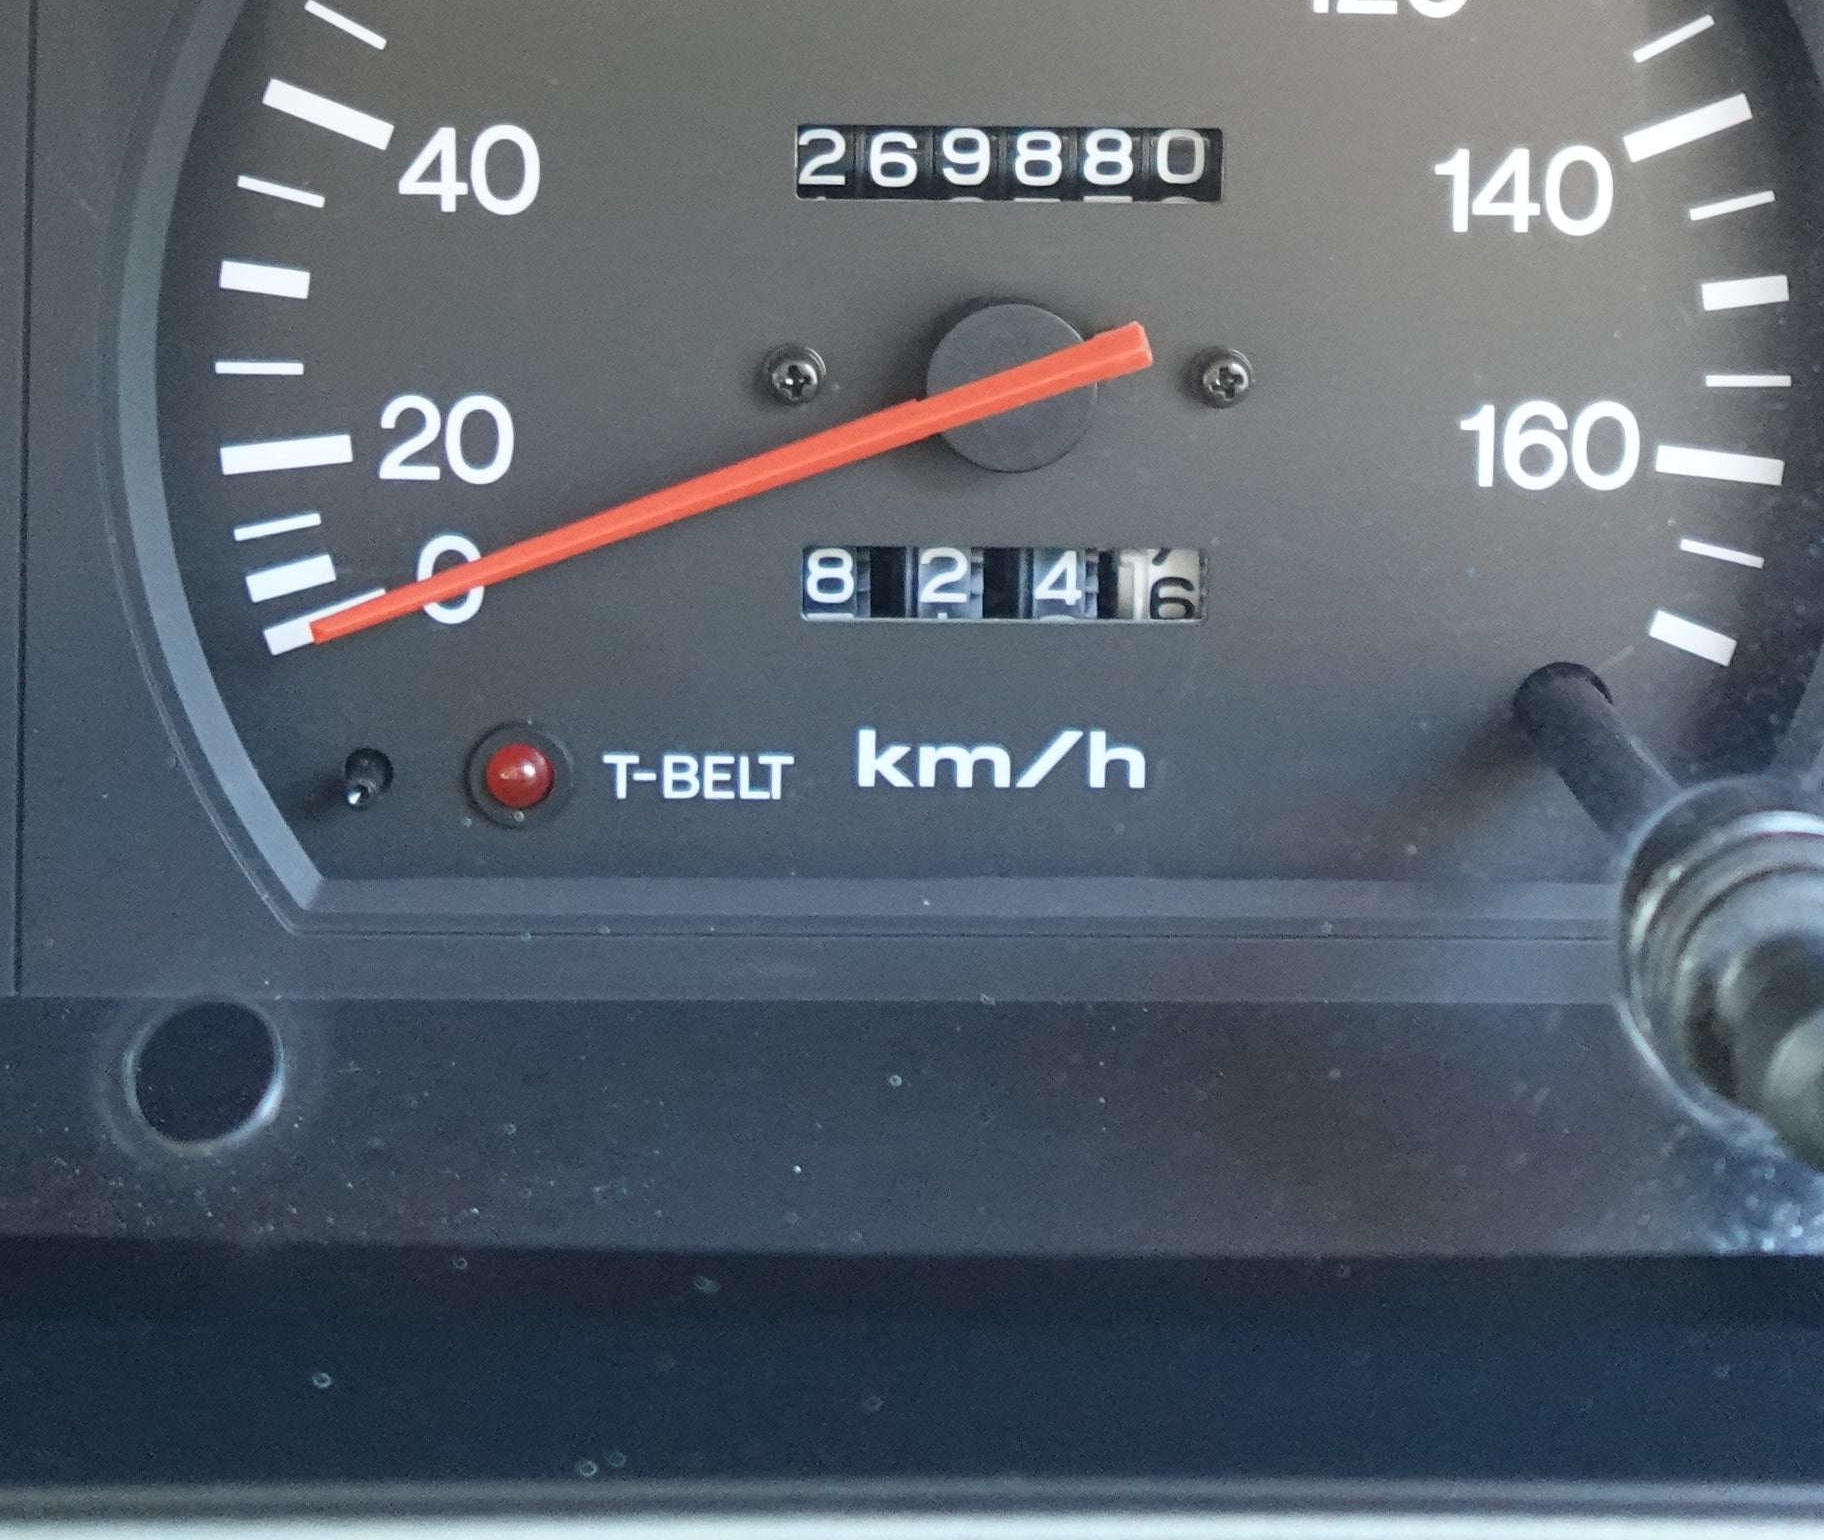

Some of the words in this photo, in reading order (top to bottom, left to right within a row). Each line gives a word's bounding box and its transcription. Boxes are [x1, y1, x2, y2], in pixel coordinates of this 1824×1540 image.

[395, 120, 542, 217] 40
[797, 128, 1206, 188] 269880
[1433, 143, 1615, 238] 140
[377, 393, 516, 486] 20
[1458, 398, 1642, 492] 160
[415, 533, 485, 625] 0
[601, 752, 796, 801] T-BELT
[856, 727, 1147, 790] km/h
